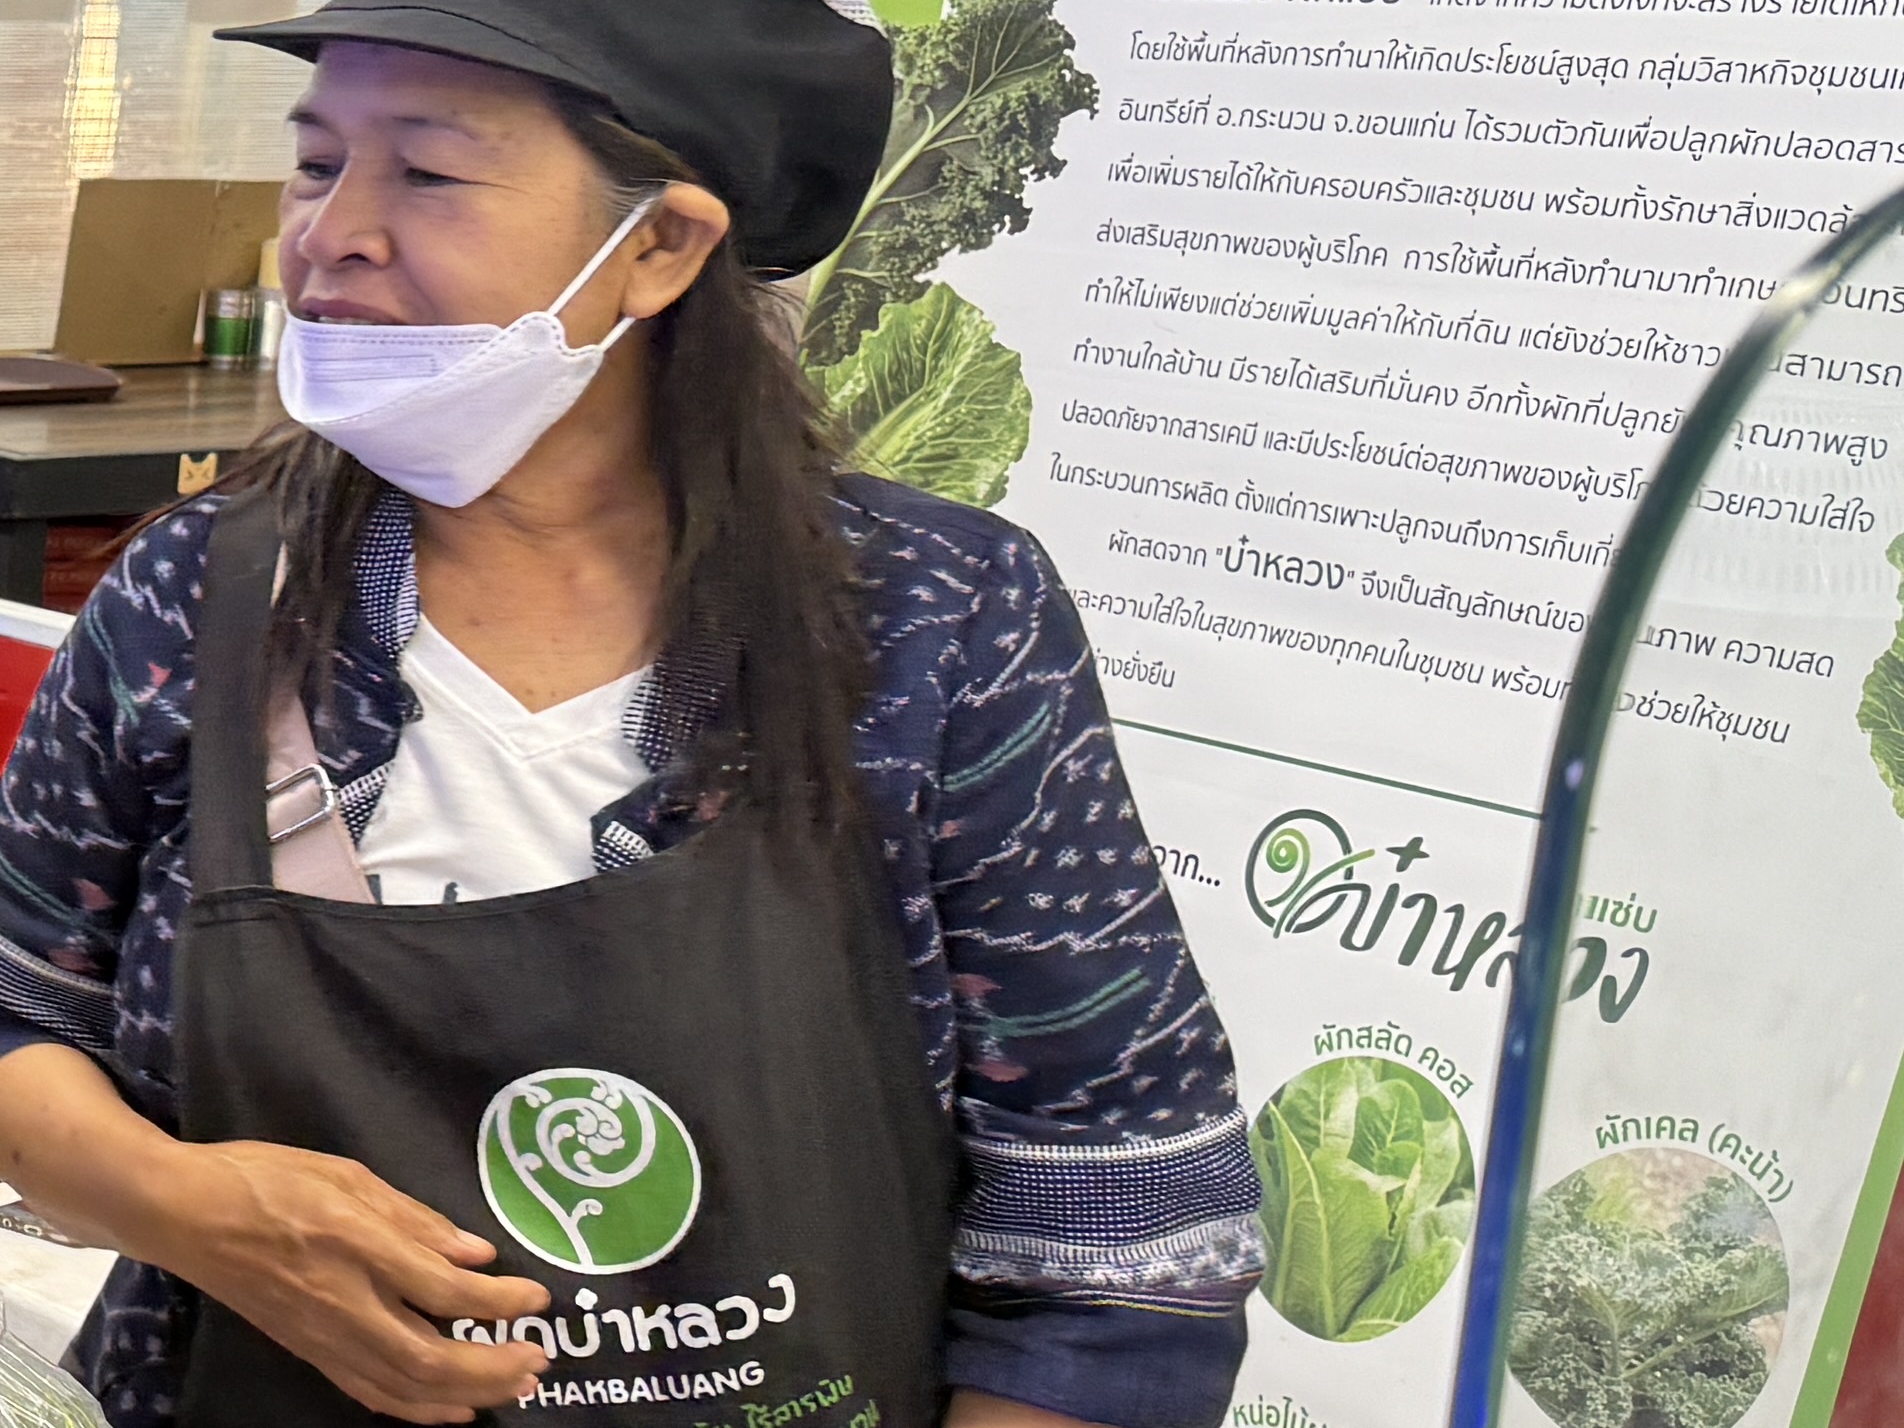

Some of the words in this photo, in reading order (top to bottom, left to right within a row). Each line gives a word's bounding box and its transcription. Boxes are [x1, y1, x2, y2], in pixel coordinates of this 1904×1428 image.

[1130, 30, 1629, 88] โดยใช้พื้นที่หลังการทำนาให้เกิดประโยชน์สูงสุด
[1118, 93, 1212, 126] อินทรีย์ที่
[1216, 107, 1325, 133] อ.กระนวน
[1333, 109, 1456, 139] จ.ขอนแก่น
[1108, 153, 1534, 216] เพื่อเพิ่มรายได้ให้กับครอบครัวและชุมชน
[1543, 184, 1856, 233] พร้อมทั้งรักษาสิ่งแวดล้
[1096, 218, 1388, 269] ส่งเสริมสุขภาพของผู้บริโภค
[1084, 275, 1511, 346] ทำให้ไม่เพียงแต่ช่วยเพิ่มมูลค่าให้กับที่ดิน
[1073, 339, 1222, 380] ทำงานใกล้บ้าน
[1228, 356, 1459, 409] มีรายได้เสริมที่มั่นคง
[1062, 400, 1259, 449] ปลอดภัยจากสารเคมี
[1049, 453, 1229, 509] ในกระบวนการผลิต
[1108, 528, 1208, 568] ผักสดจาก
[1723, 638, 1835, 679] ความสด
[1313, 1021, 1413, 1058] ผักสลัด
[1418, 1045, 1475, 1100] คอส
[1595, 1113, 1700, 1150] ผักเคล
[1706, 1123, 1796, 1205] (คะน้า)
